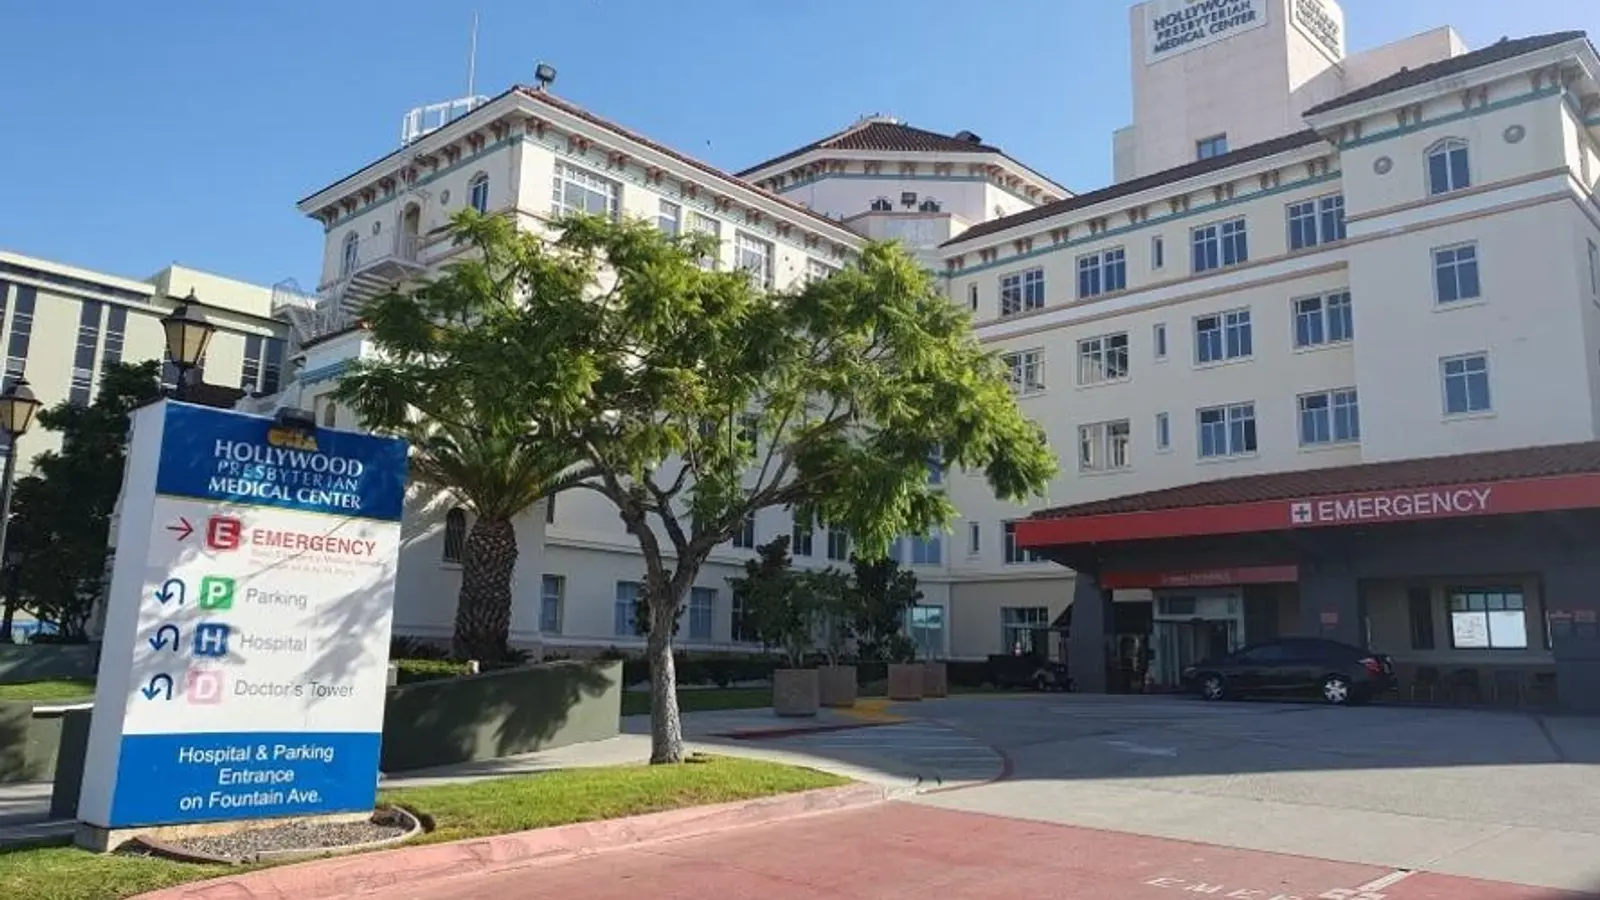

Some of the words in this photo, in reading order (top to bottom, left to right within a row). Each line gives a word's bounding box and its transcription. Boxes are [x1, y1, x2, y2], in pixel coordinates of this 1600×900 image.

[1153, 0, 1238, 31] HOLLYWO
[1157, 0, 1251, 41] PRESBYTERIAN
[1154, 27, 1205, 53] MEDICAL
[1209, 10, 1256, 34] CENTER
[214, 439, 363, 477] HOLLYWOOD
[217, 460, 358, 491] PRESBYTERIAN
[208, 476, 291, 501] MEDICAL
[297, 488, 361, 509] CENTER
[1318, 487, 1491, 521] EMERGENCY
[252, 529, 376, 556] EMERGENCY
[246, 587, 307, 610] Parking
[240, 634, 307, 654] Hospital
[234, 679, 302, 698] Doctor's
[310, 681, 354, 698] Tower
[178, 745, 250, 765] Hospital
[256, 745, 268, 761] &
[274, 744, 334, 763] Parking
[219, 767, 294, 785] Entrance
[180, 796, 203, 811] on
[208, 790, 283, 809] Fountain
[287, 788, 322, 804] Ave.
